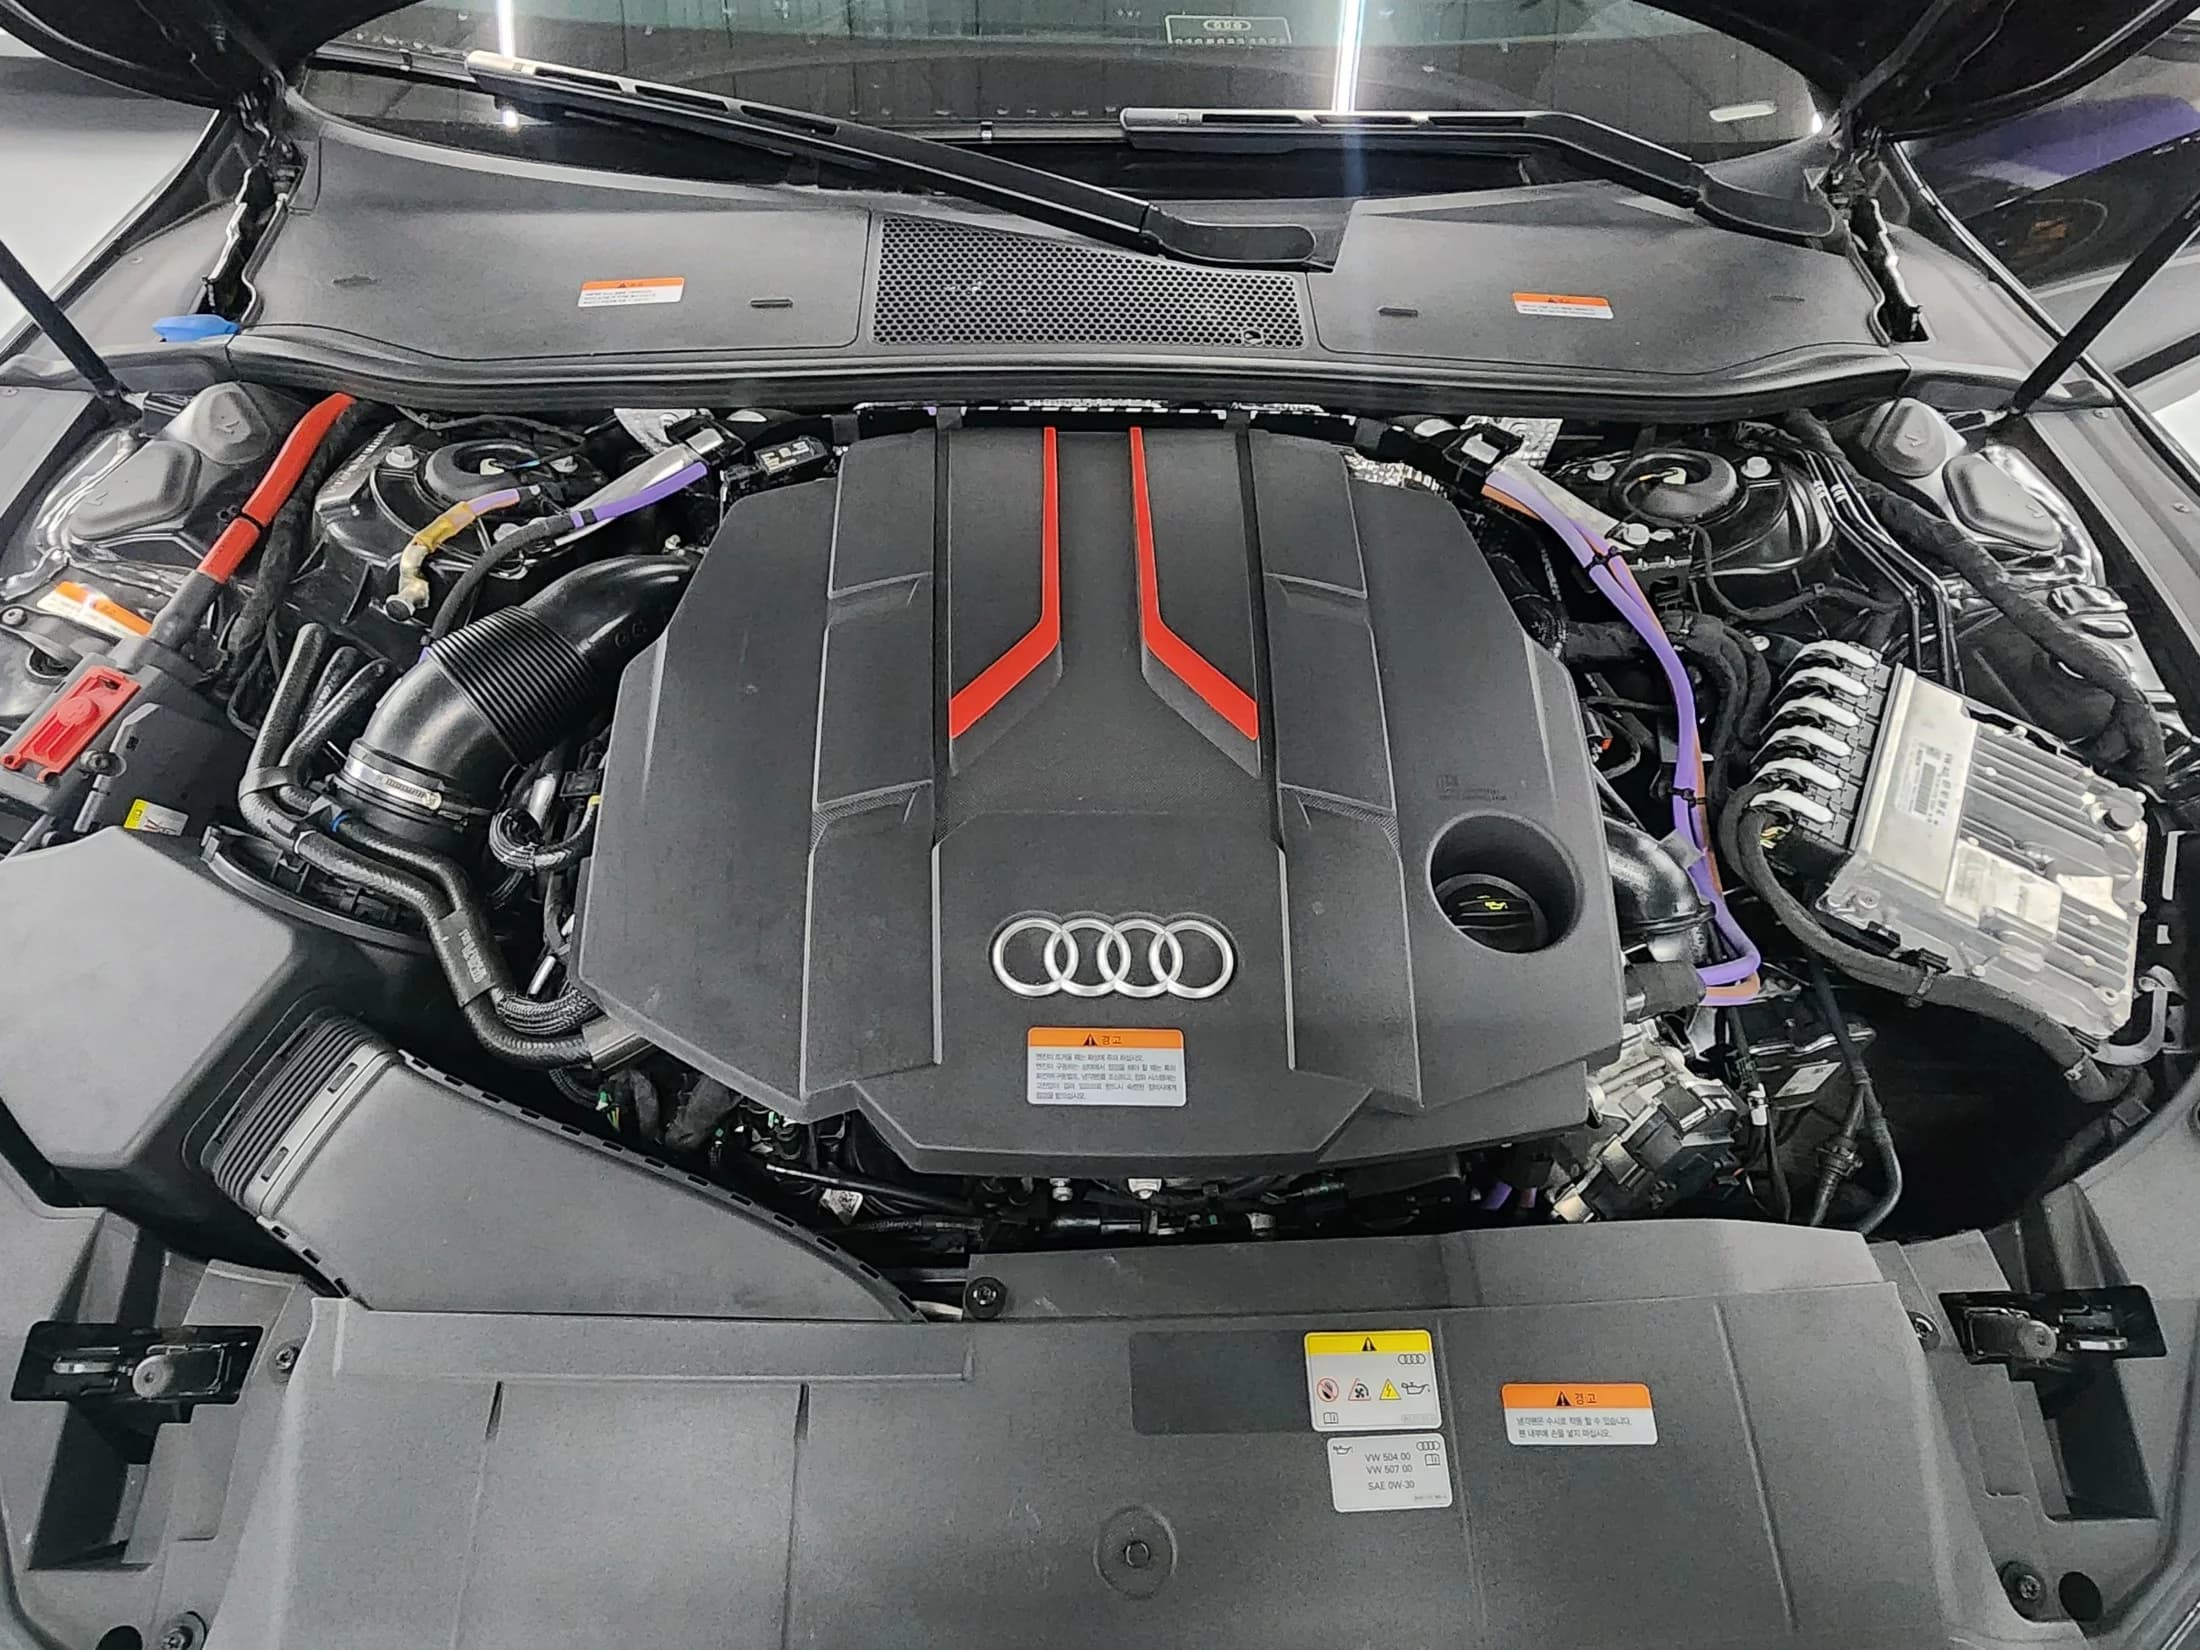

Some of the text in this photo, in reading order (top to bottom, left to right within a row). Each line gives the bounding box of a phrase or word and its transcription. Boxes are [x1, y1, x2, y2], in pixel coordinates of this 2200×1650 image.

[1575, 1393, 1597, 1404] 경고
[1365, 1452, 1411, 1462] VW 504 00
[1366, 1464, 1413, 1474] VW 507 00
[1368, 1480, 1415, 1491] SAE 0W-30
